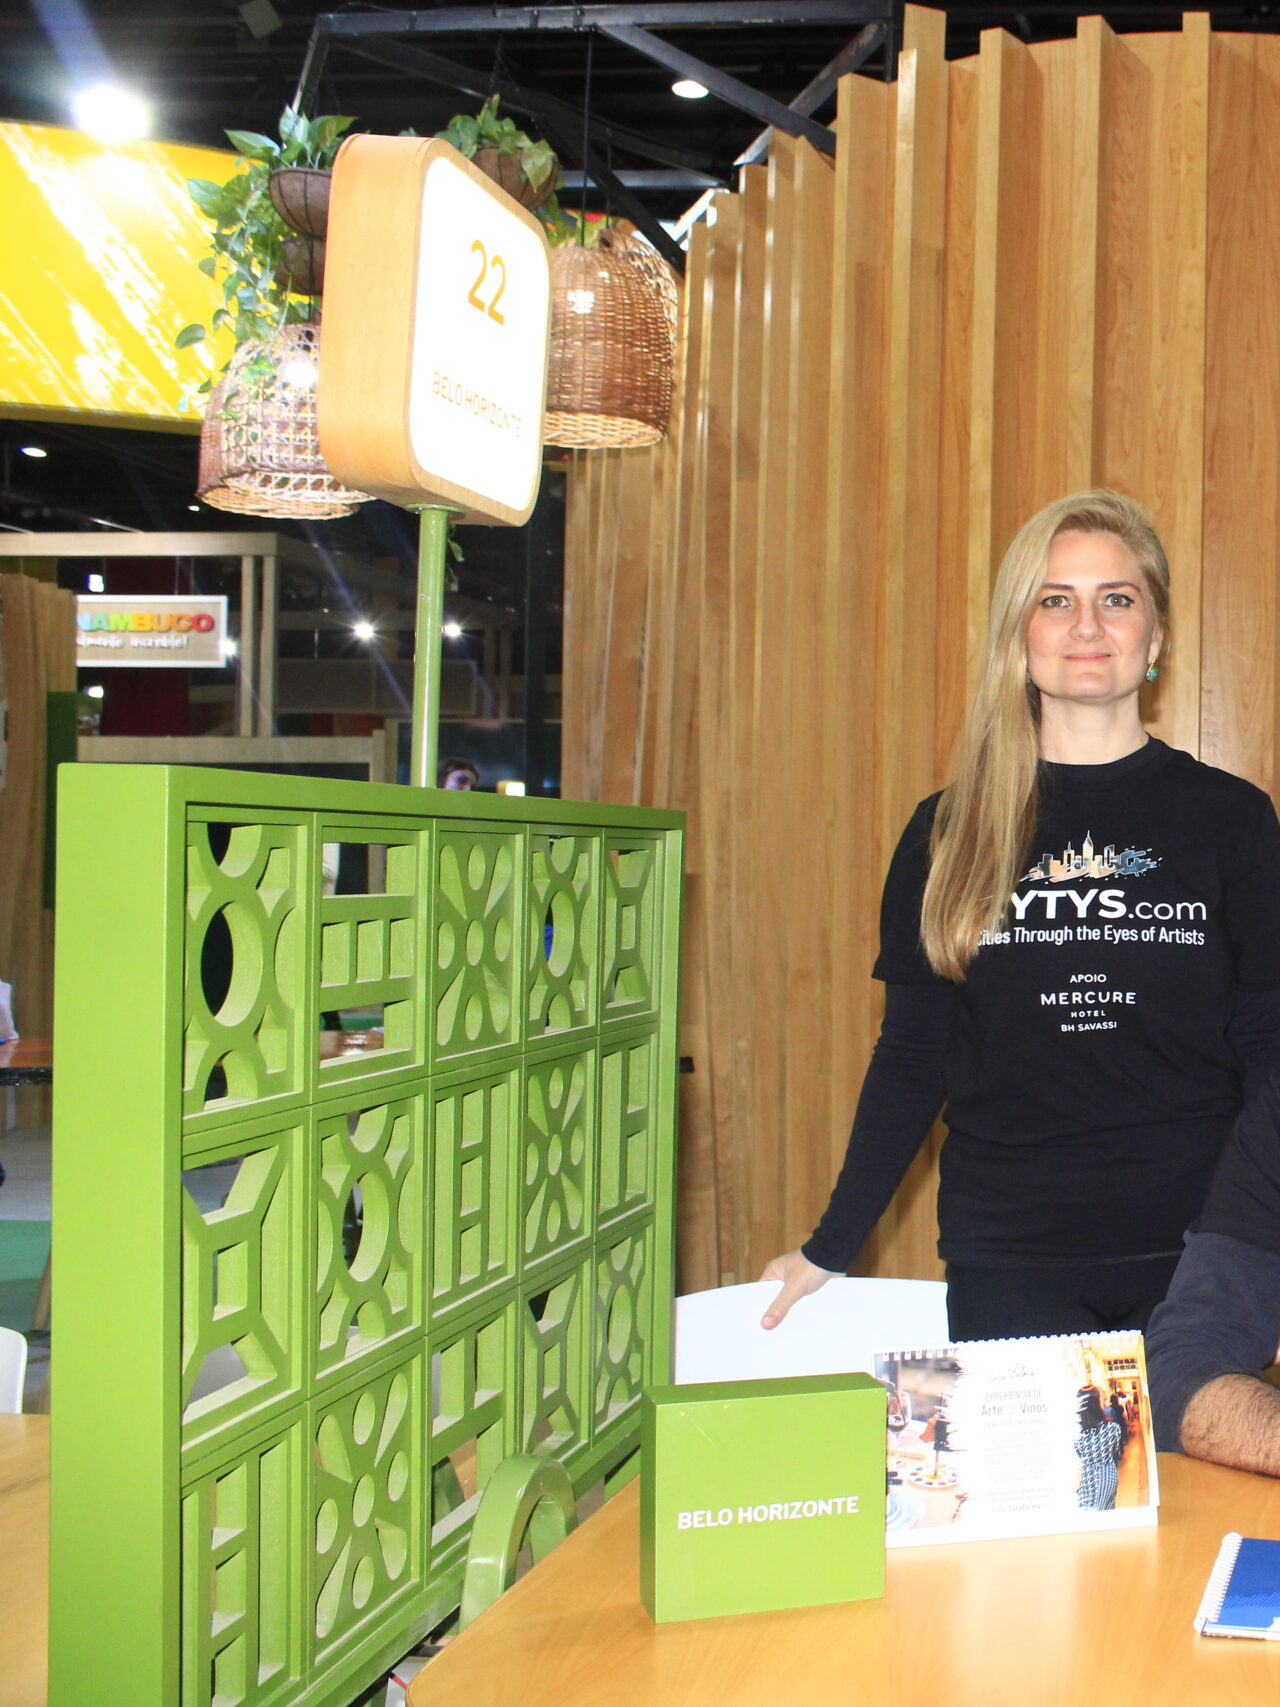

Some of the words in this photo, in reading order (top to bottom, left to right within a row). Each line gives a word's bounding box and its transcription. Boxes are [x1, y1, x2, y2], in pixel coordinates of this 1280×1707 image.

[467, 239, 506, 326] 22
[432, 371, 464, 406] BELO
[465, 388, 523, 439] HORIZONTE
[1010, 888, 1207, 921] YTYS.com
[1013, 926, 1073, 946] Through
[1077, 925, 1101, 941] the
[1104, 925, 1138, 944] Eyes
[1141, 926, 1156, 942] of
[1159, 927, 1205, 945] Artists
[1069, 974, 1107, 984] APOIO
[1040, 991, 1137, 1006] MERCURE
[1070, 1010, 1106, 1018] HOTEL
[1060, 1024, 1075, 1032] BH
[1077, 1021, 1117, 1032] SAVASSI
[981, 1404, 1004, 1417] Arte
[1020, 1402, 1048, 1415] Vinos
[677, 1507, 734, 1530] BELO
[737, 1495, 860, 1524] HORIZONTE
